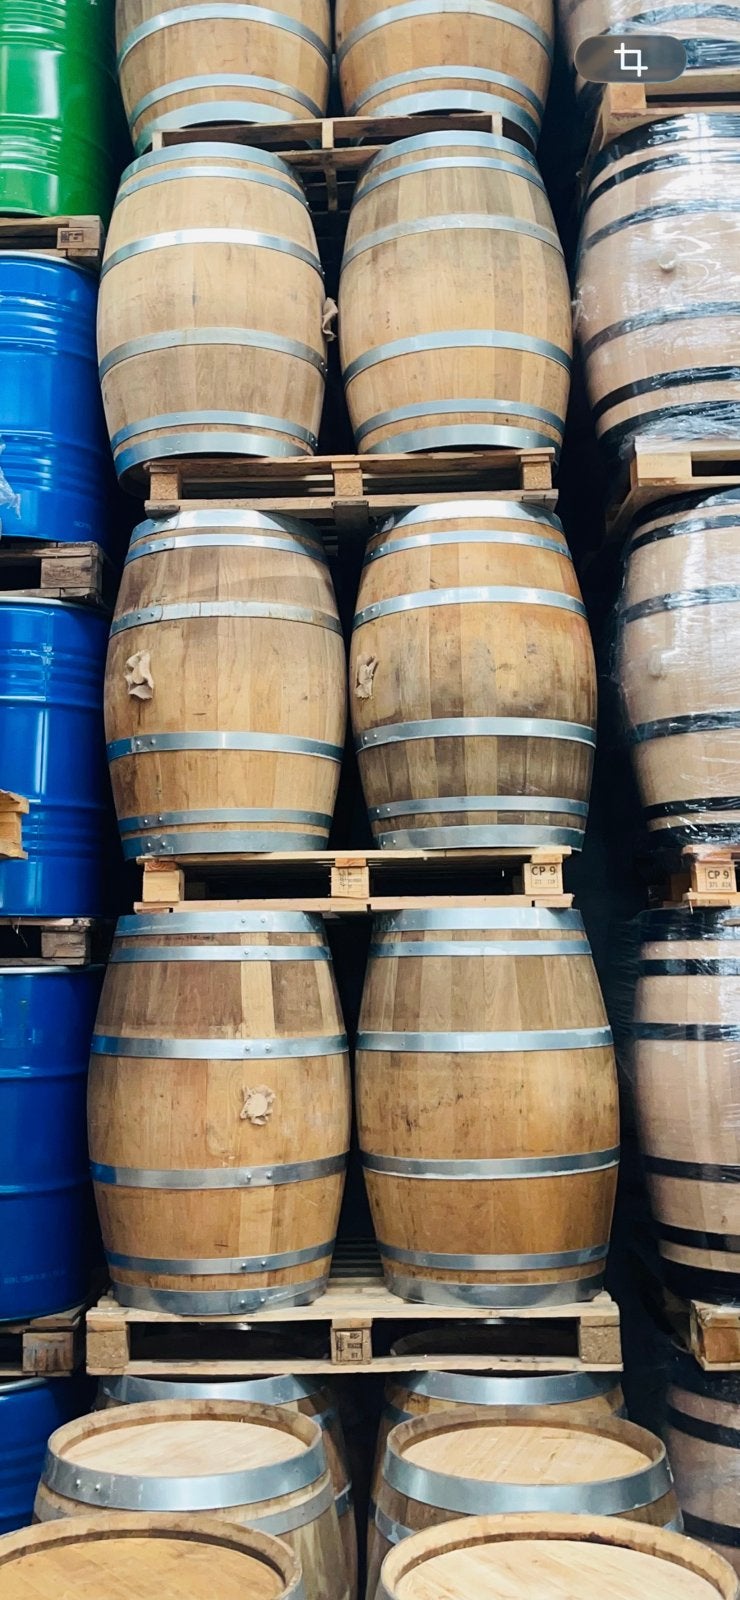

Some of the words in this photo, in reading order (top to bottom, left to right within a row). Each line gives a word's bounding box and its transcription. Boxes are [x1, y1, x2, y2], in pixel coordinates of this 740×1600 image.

[531, 866, 546, 876] CP
[550, 866, 556, 876] 9
[707, 870, 720, 879] CP
[722, 870, 730, 879] 9
